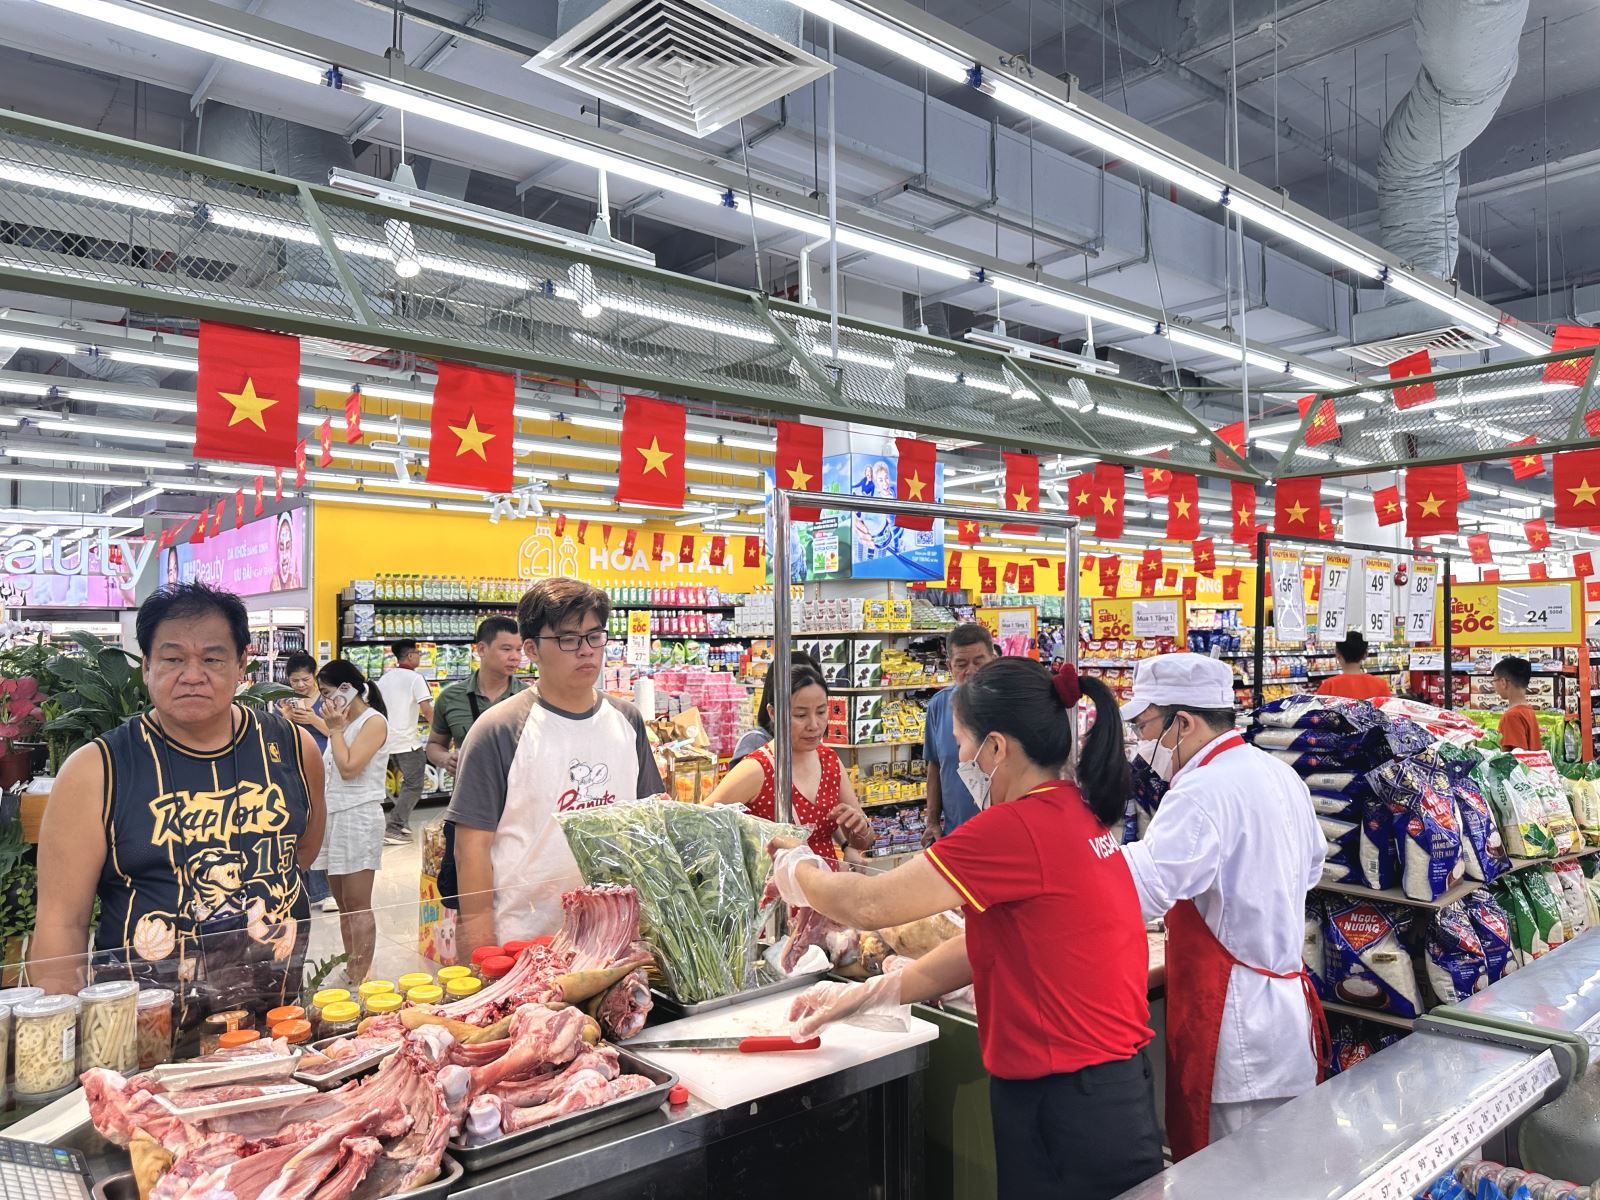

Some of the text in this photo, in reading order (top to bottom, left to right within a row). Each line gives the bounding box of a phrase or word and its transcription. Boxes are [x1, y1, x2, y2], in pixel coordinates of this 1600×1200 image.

[590, 540, 650, 571] HÓA
[1329, 570, 1341, 587] 97
[1371, 575, 1384, 592] 49
[1416, 577, 1428, 592] 83
[1325, 611, 1337, 628] 85
[1370, 614, 1383, 630] 95
[1412, 614, 1424, 629] 75
[1527, 610, 1547, 623] 24
[1418, 656, 1432, 665] 27
[252, 834, 297, 877] 15
[1350, 913, 1378, 924] NGỌC
